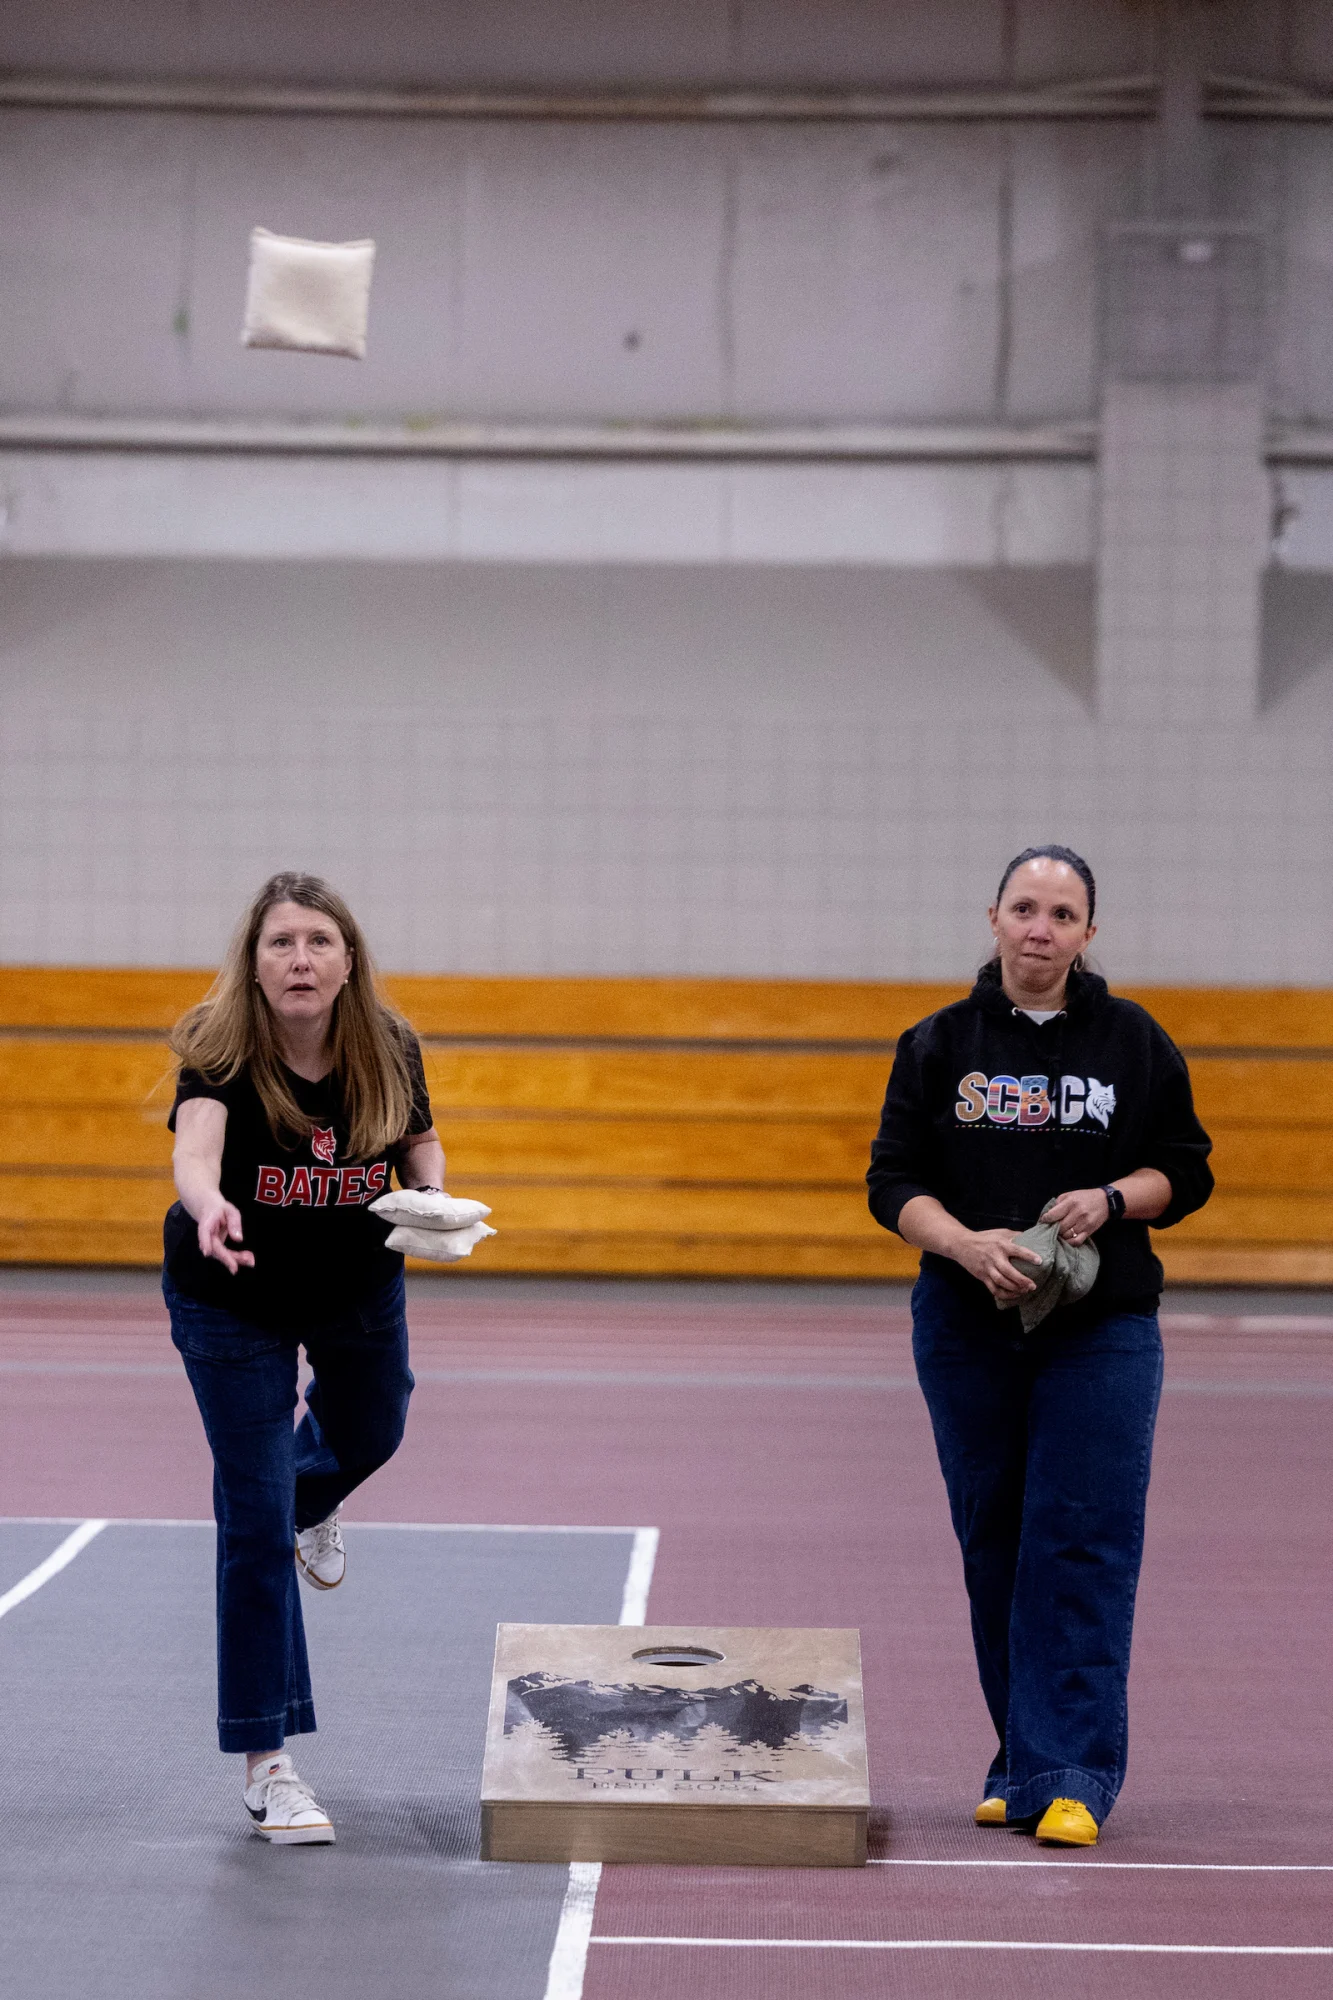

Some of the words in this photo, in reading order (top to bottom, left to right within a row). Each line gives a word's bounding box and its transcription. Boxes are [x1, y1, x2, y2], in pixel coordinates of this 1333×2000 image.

[954, 1071, 1086, 1125] SCBC
[254, 1161, 387, 1207] BATES
[567, 1767, 784, 1782] PULK
